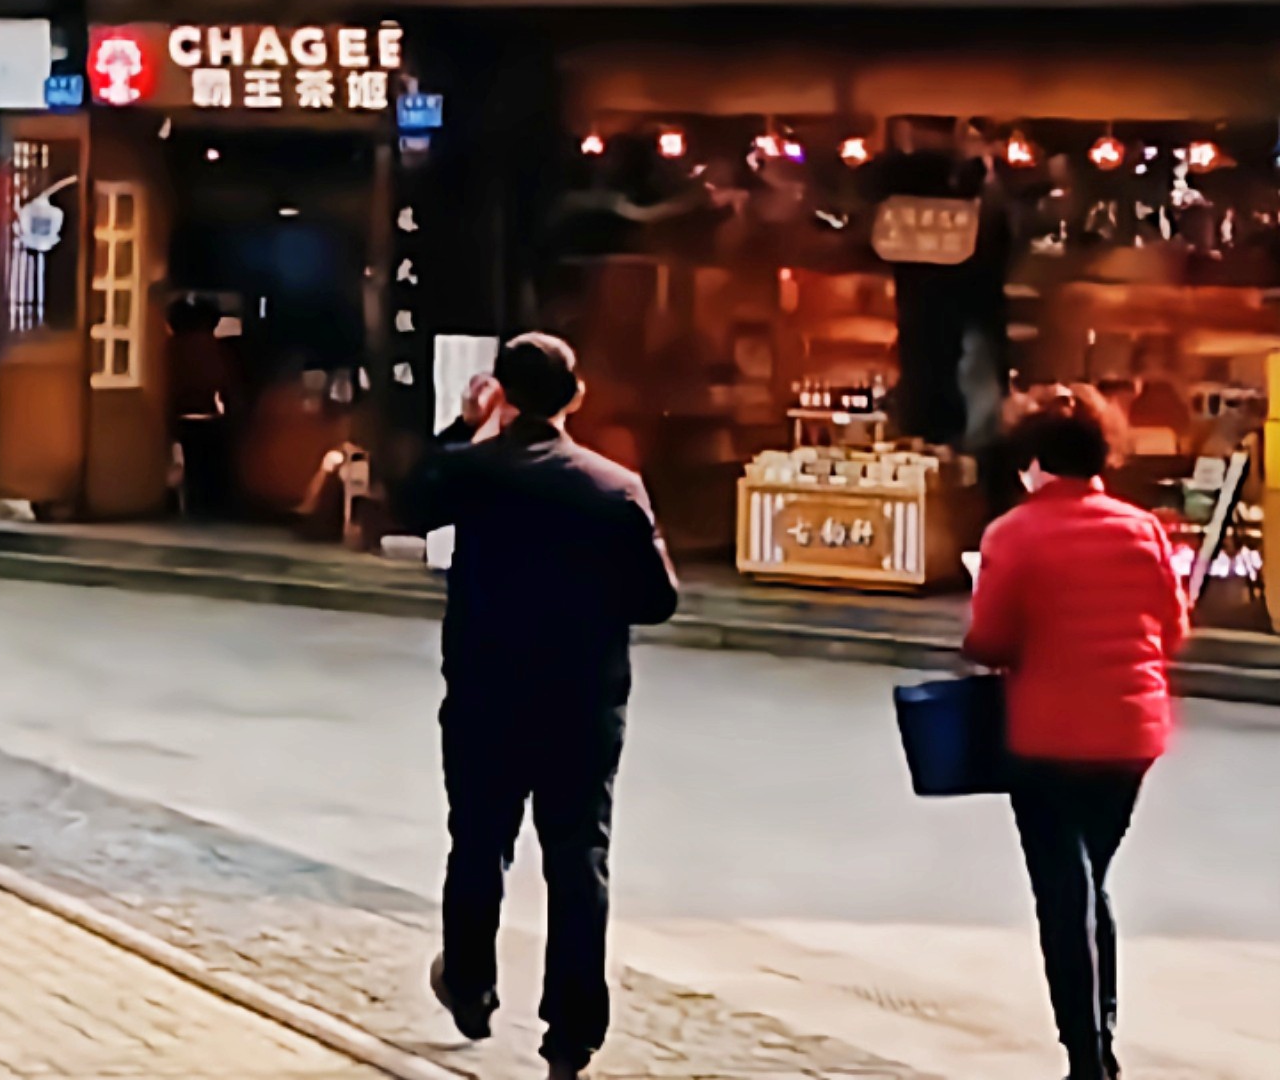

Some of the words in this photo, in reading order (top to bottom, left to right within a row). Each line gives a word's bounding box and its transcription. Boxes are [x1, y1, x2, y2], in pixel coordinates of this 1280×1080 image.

[169, 25, 403, 68] CHAGEE
[192, 68, 389, 109] 霸王茶姬
